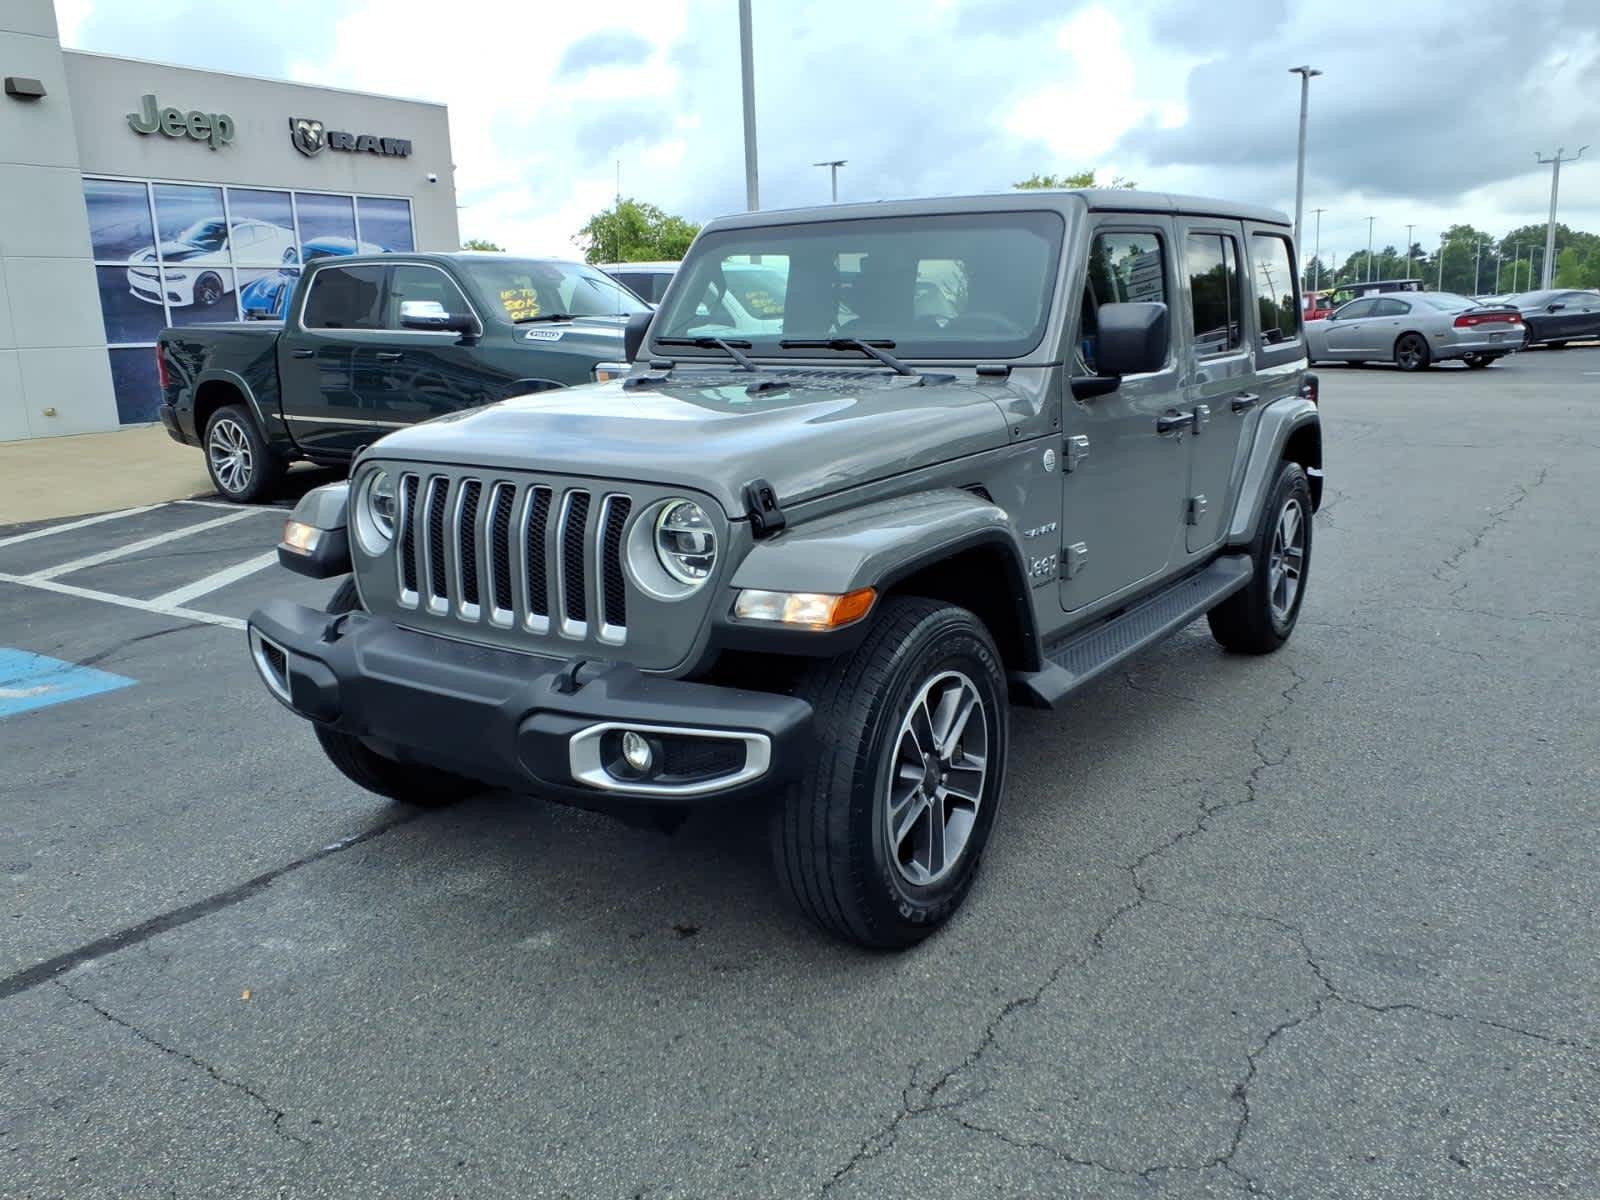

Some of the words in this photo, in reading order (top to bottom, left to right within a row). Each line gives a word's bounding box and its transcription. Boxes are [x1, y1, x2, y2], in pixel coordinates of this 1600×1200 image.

[127, 94, 234, 151] Jeep
[328, 131, 412, 158] RAM
[511, 307, 541, 320] OFF
[1029, 553, 1057, 577] Jeep
